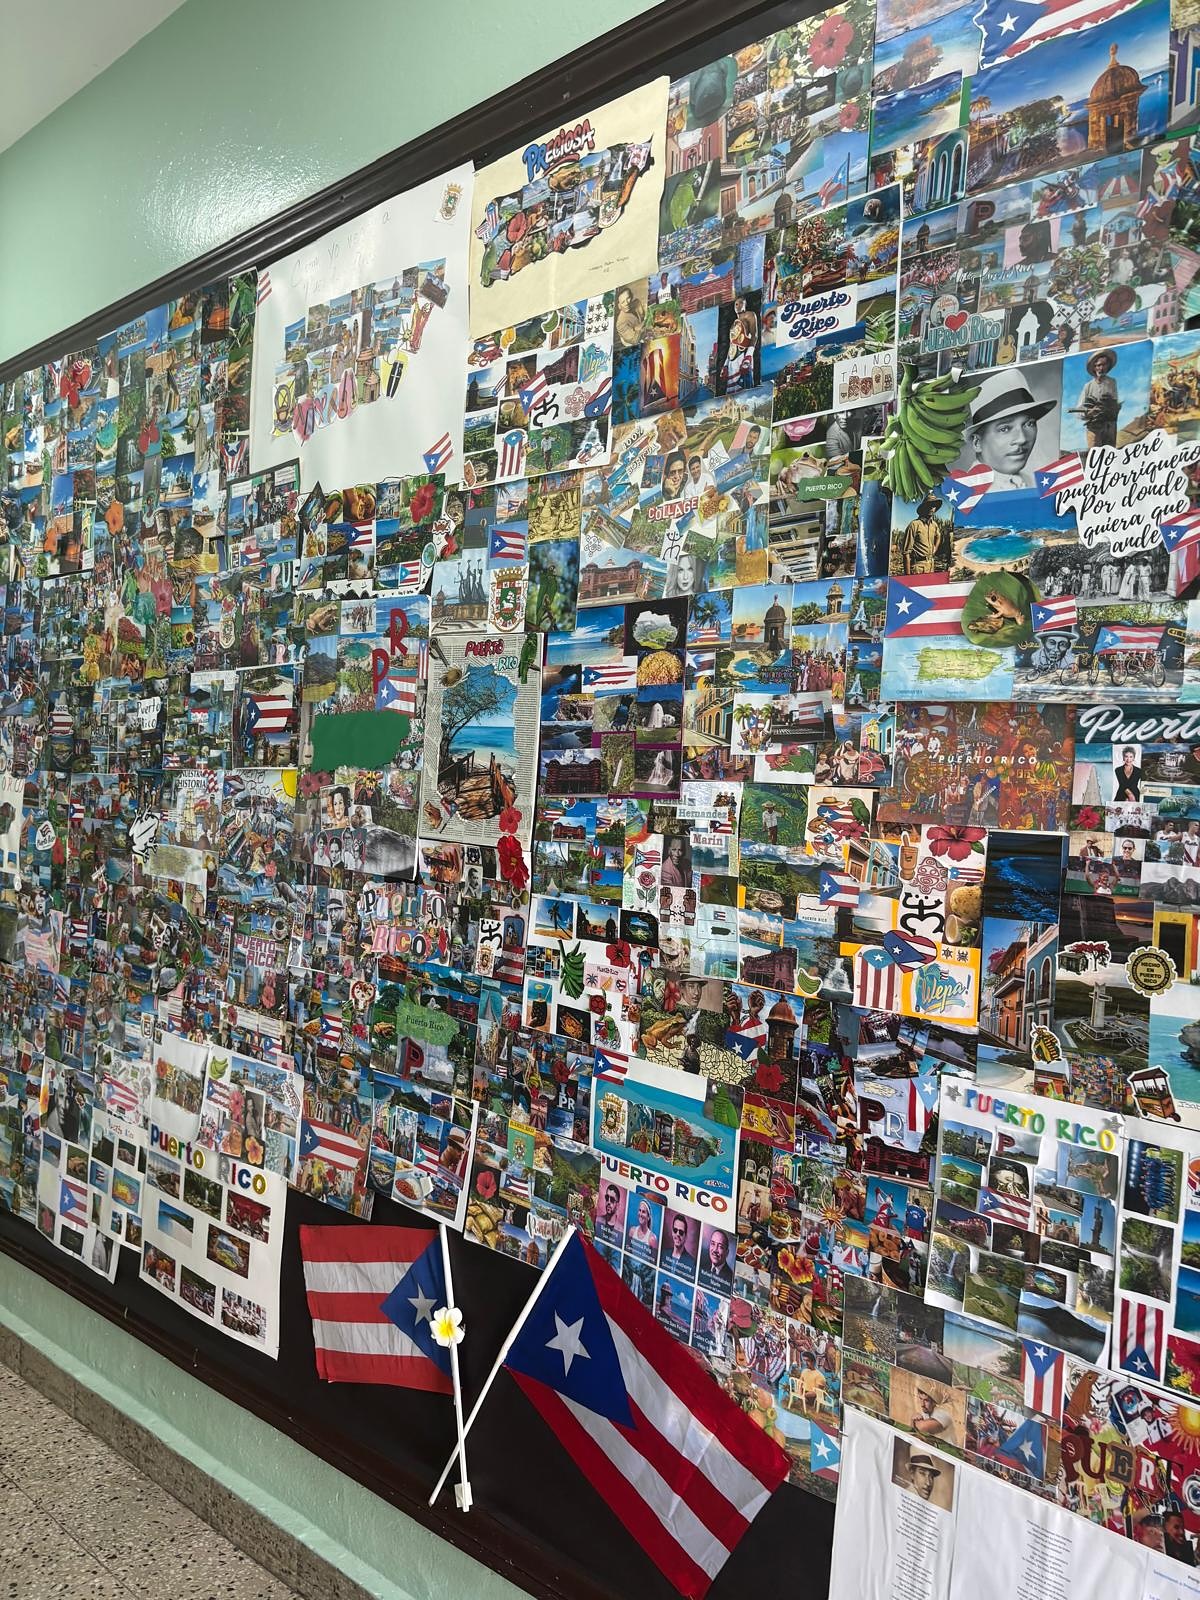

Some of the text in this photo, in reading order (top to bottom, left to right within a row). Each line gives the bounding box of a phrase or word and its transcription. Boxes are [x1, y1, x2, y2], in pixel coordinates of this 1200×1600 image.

[522, 118, 596, 182] PRECIOSA
[780, 290, 851, 323] Puerto
[788, 313, 839, 341] Rico
[921, 325, 967, 353] PUERTO
[1089, 431, 1164, 482] Yo seré
[804, 481, 843, 493] PUERTO RICO
[1056, 444, 1200, 515] puertorriqueño
[647, 495, 699, 523] COLLAGE
[1079, 470, 1188, 520] Por donde
[1083, 498, 1188, 546] quiera que
[1111, 524, 1161, 553] ande
[464, 638, 505, 658] PUERTO
[497, 656, 519, 672] RICO
[1079, 704, 1200, 745] Puert
[937, 755, 1037, 765] PUERTO RICO
[177, 778, 207, 789] HISTORIA
[677, 807, 727, 820] Hernandez
[364, 888, 447, 919] Puerto
[234, 933, 276, 954] PUERTO
[246, 951, 276, 968] RICO
[920, 973, 972, 1011] Wepa!
[405, 1014, 445, 1032] Puerto Rico
[558, 1093, 575, 1110] PR
[963, 1088, 1115, 1152] PUERTO RICO
[675, 1183, 728, 1213] RICO
